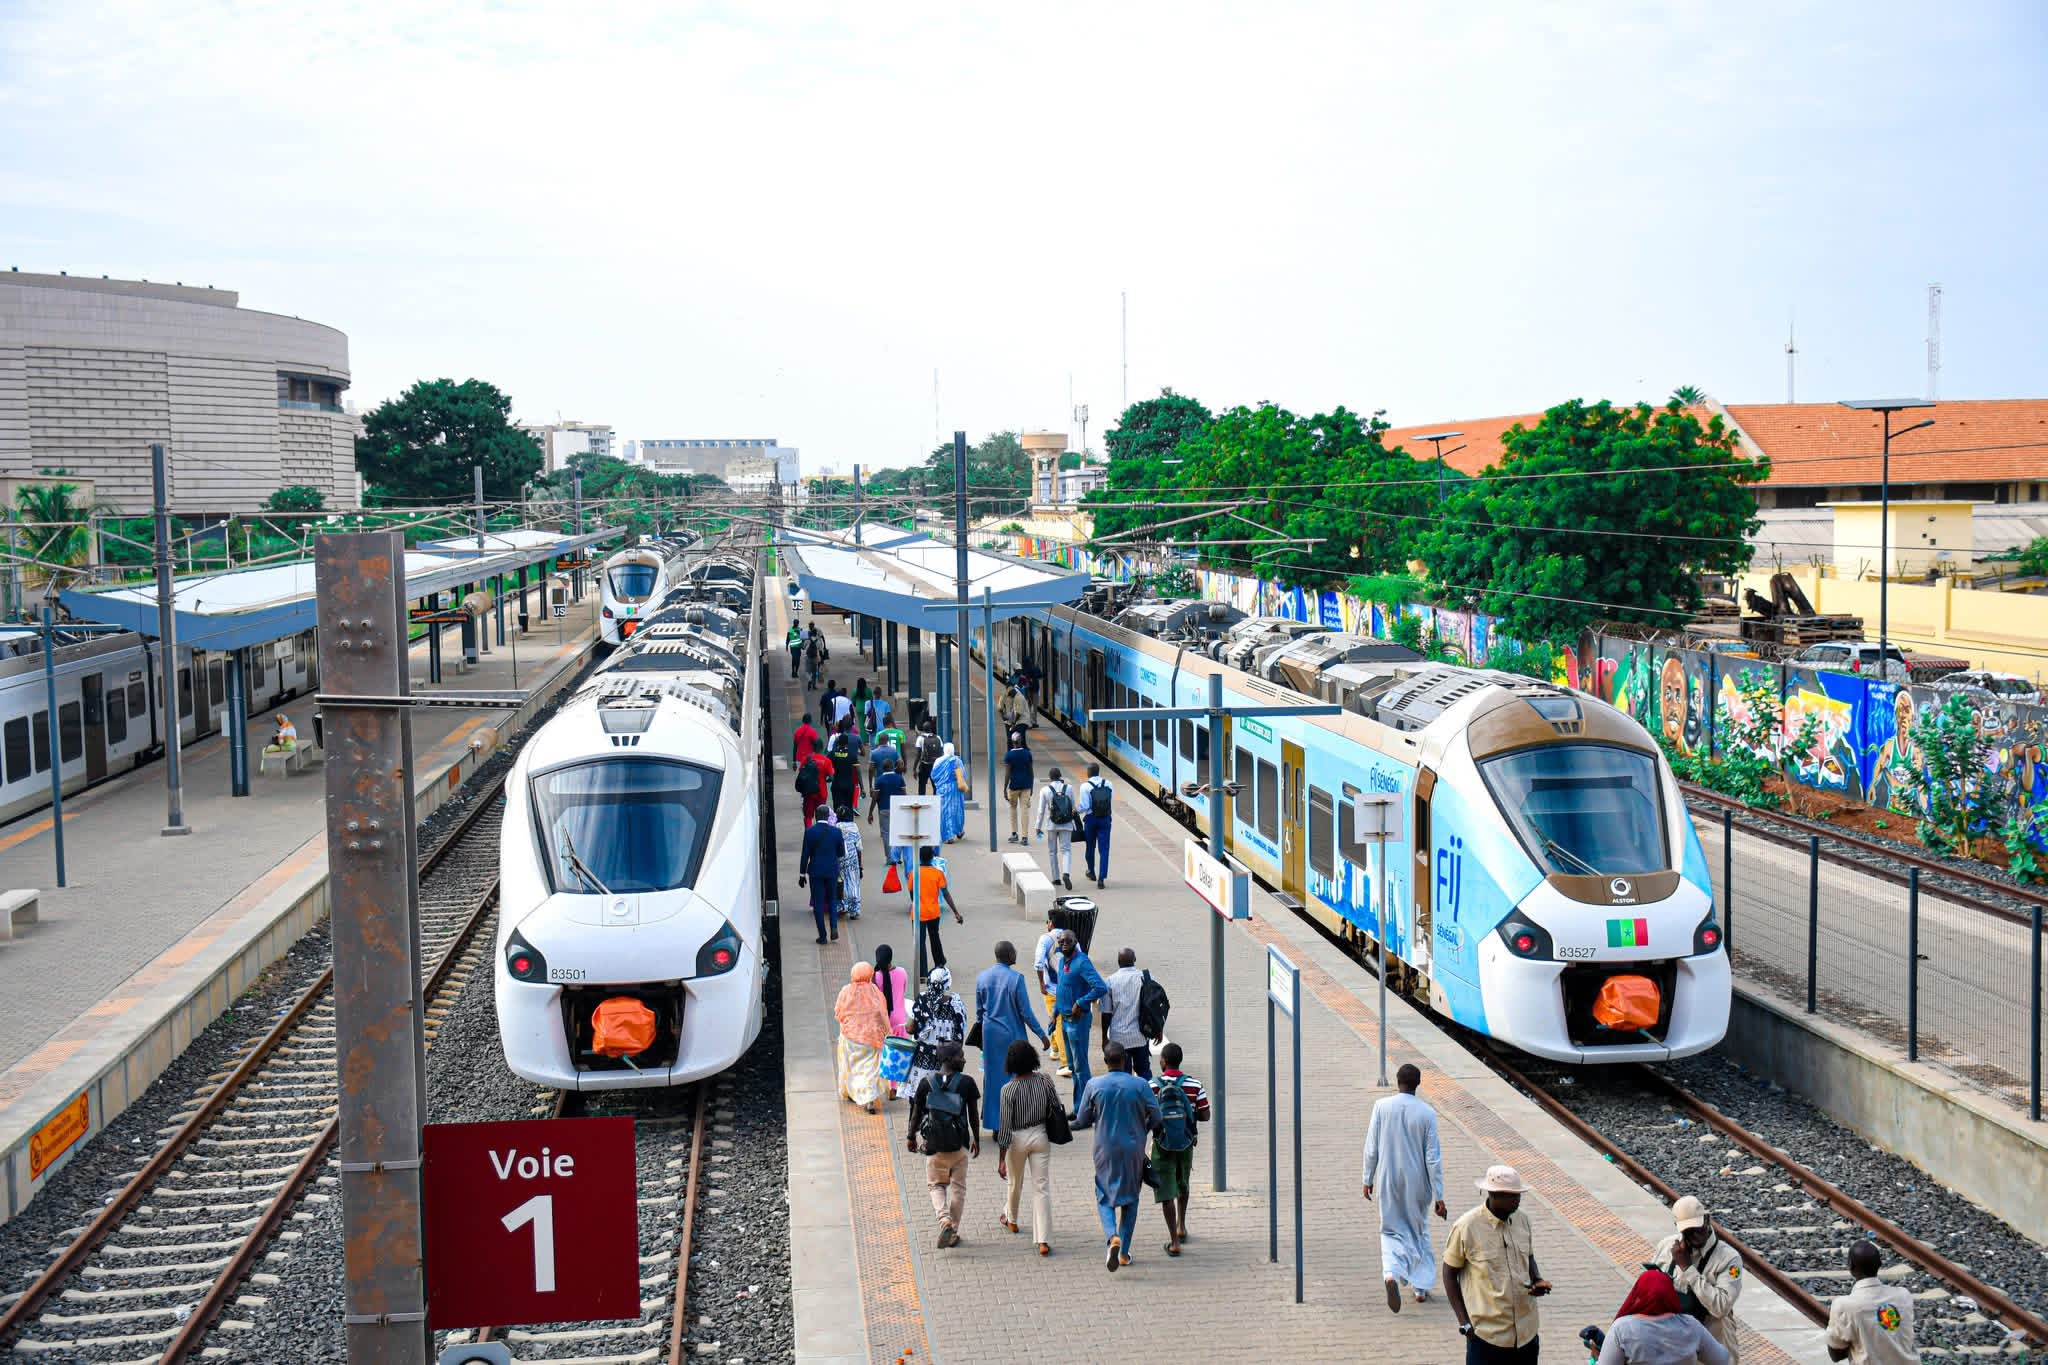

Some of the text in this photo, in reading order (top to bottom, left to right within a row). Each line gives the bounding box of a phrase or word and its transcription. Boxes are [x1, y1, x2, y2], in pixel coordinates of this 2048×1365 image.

[553, 605, 567, 617] US
[1199, 863, 1213, 889] Dakar
[1559, 947, 1597, 958] 83527
[551, 968, 586, 980] 83501
[488, 1147, 575, 1180] Voie
[500, 1194, 556, 1293] 1
